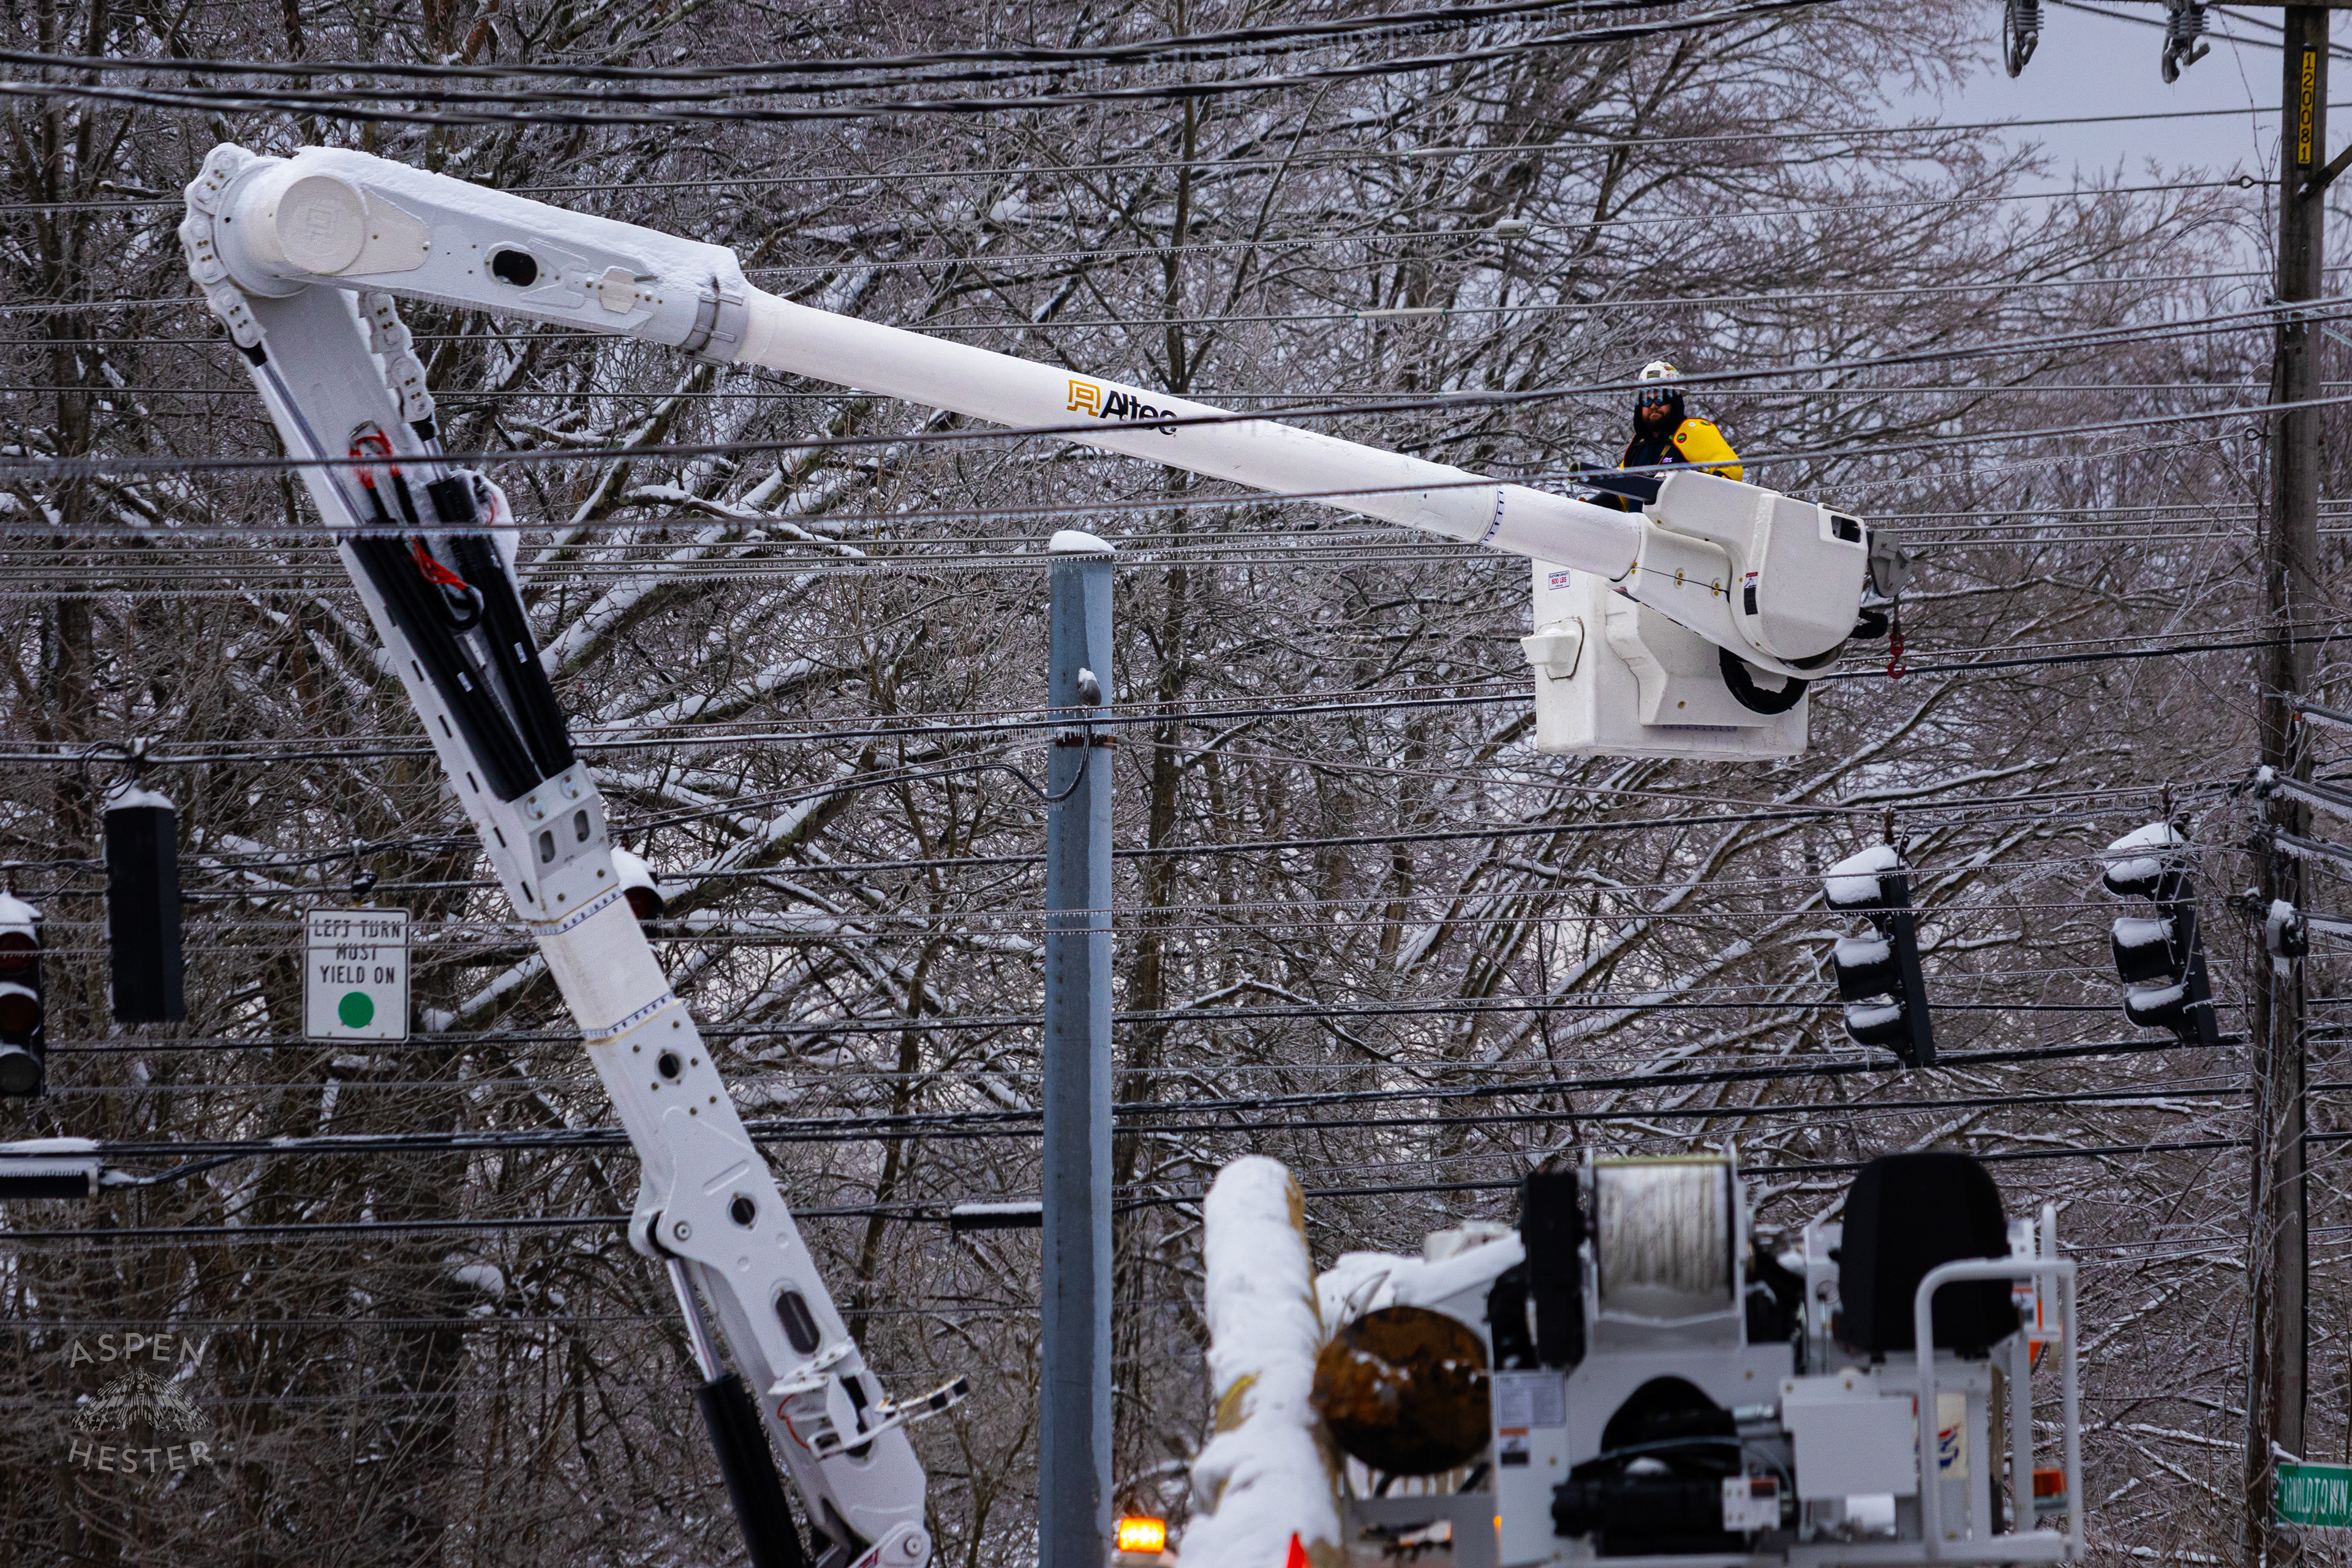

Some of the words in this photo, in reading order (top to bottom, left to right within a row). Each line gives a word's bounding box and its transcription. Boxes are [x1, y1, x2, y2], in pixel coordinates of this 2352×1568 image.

[2301, 54, 2313, 162] 120081
[1099, 390, 1178, 435] Altec
[314, 919, 350, 938] LEFT
[360, 920, 401, 938] TURN
[336, 943, 378, 960] MUST
[320, 965, 365, 983] YIELD
[374, 967, 395, 984] ON
[2283, 1476, 2349, 1516] ARNOLDTOWN
